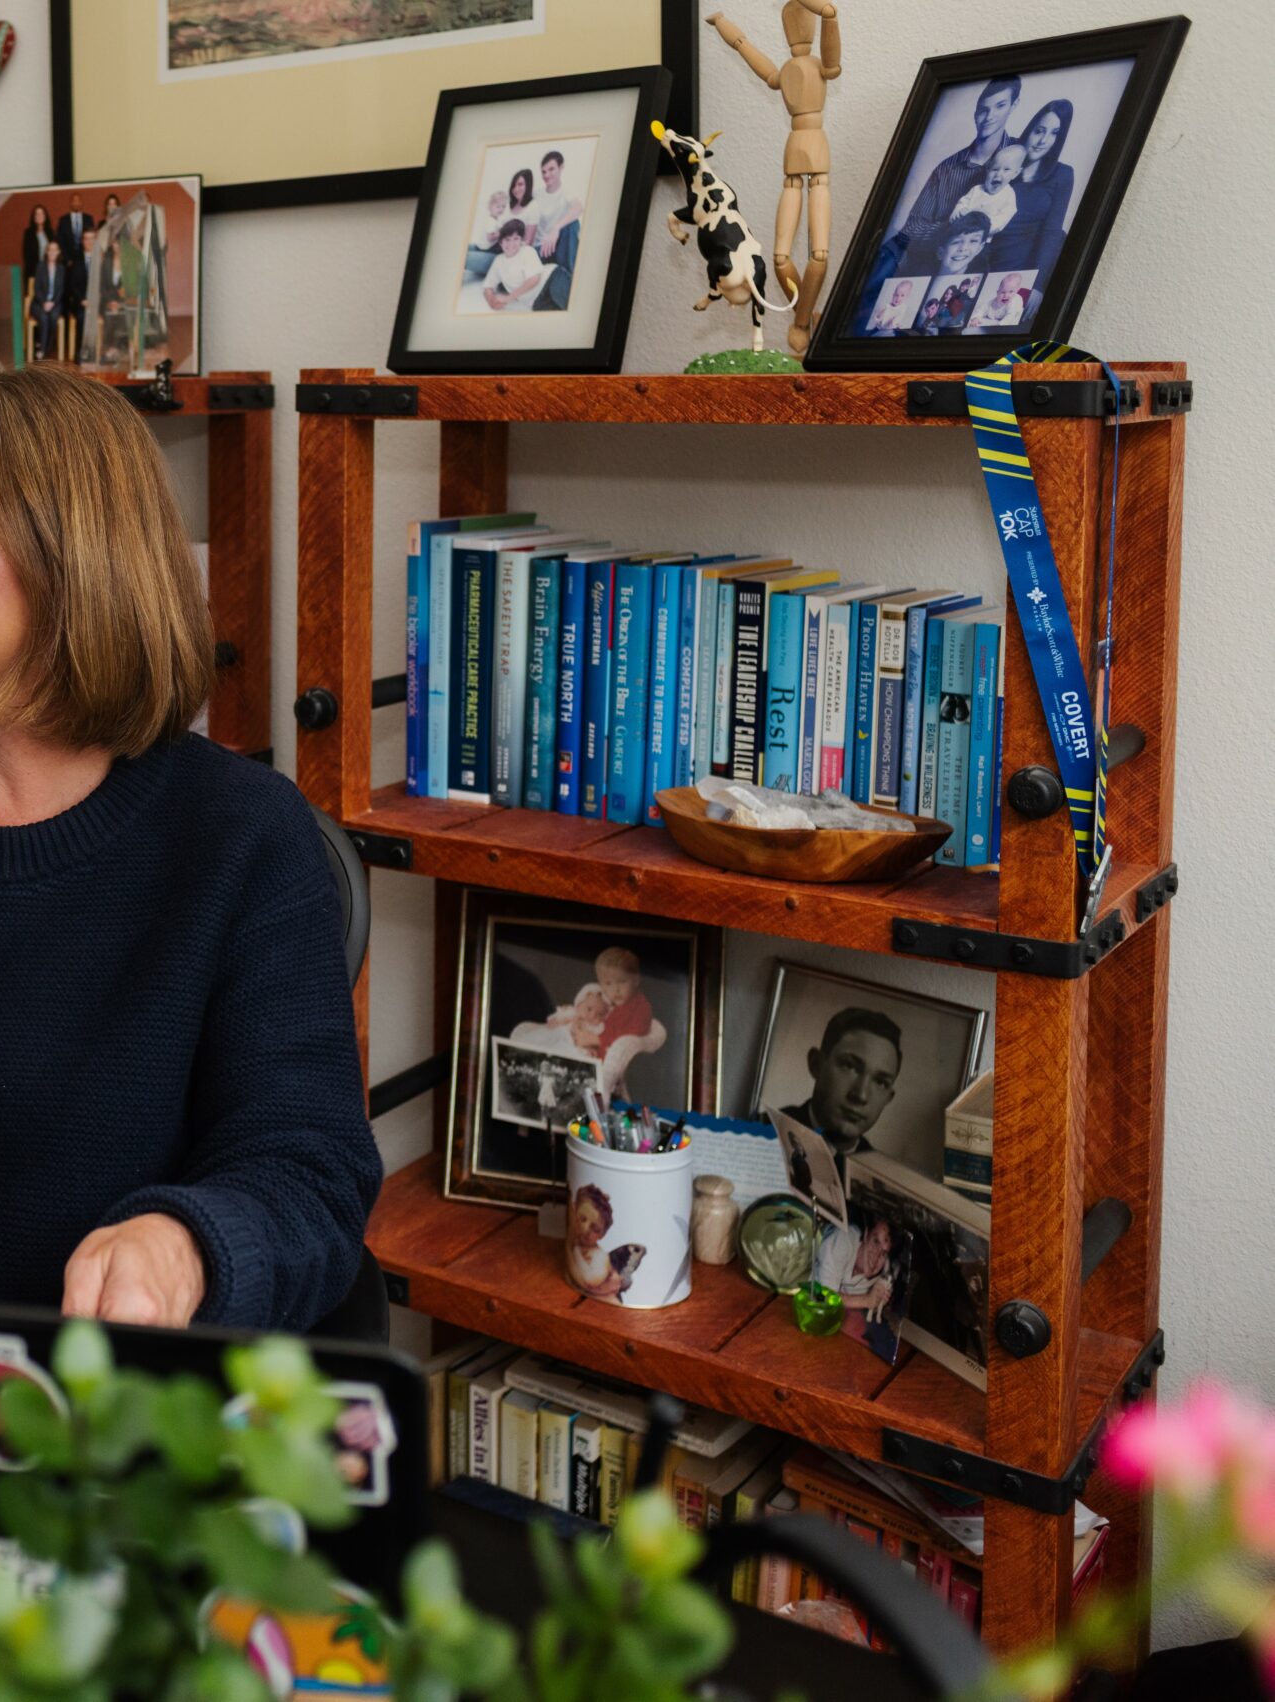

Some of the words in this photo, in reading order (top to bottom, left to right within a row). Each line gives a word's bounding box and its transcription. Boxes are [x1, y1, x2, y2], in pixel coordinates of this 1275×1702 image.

[999, 510, 1019, 541] 10K
[1014, 507, 1034, 538] CAP
[502, 561, 513, 584] THE
[1027, 551, 1037, 578] PRESENTED
[407, 596, 418, 614] the
[501, 590, 512, 637] SAFETY
[534, 576, 551, 620] Brain
[590, 581, 605, 614] Office
[467, 570, 481, 660] PHARMACEUTICAL
[618, 608, 633, 646] ORIGIN
[910, 610, 919, 635] LOOK
[1032, 605, 1043, 632] HEALTH
[406, 617, 419, 656] bipolar
[562, 623, 576, 665] TRUE
[590, 615, 602, 666] SUPERMAN
[655, 608, 668, 682] COMMUNICATE
[738, 625, 759, 647] THE
[809, 627, 818, 648] LOVE
[861, 617, 875, 659] PROOF
[883, 625, 892, 662] ROTELLA
[892, 644, 900, 661] BOB
[909, 637, 918, 648] AT
[500, 642, 511, 676] TRAP
[529, 625, 550, 684] Energy
[617, 647, 627, 662] OF
[808, 650, 817, 674] LIVES
[948, 629, 956, 688] NIFFENEGGER
[406, 659, 418, 717] workbook
[466, 661, 479, 689] CARE
[617, 664, 627, 685] THE
[654, 684, 665, 697] TO
[680, 646, 692, 708] COMPLEX
[735, 650, 758, 724] LEADERSHIP
[806, 675, 816, 699] HERE
[927, 670, 938, 697] BROWN
[560, 669, 575, 723] NORTH
[834, 669, 842, 714] AMERICAN
[859, 671, 873, 723] HEAVEN
[884, 682, 894, 706] HOW
[465, 690, 478, 738] PRACTICE
[651, 699, 664, 754] INFLUENCE
[768, 685, 796, 753] Rest
[825, 690, 833, 734] PARADOX
[906, 702, 916, 729] ABOVE
[974, 697, 985, 741] parenting
[1061, 691, 1090, 759] COVERT
[678, 713, 691, 746] PTSD
[882, 707, 893, 763] CHAMPIONS
[925, 723, 935, 753] BRAVING
[803, 737, 813, 769] MARIA
[942, 729, 952, 805] TRAVELER'S
[954, 755, 962, 781] THE
[978, 755, 986, 768] Hal
[881, 764, 891, 793] THINK
[922, 764, 933, 810] WILDERNESS
[976, 769, 985, 799] Runkel,
[953, 785, 961, 817] TIME
[474, 1392, 489, 1441] Allies
[474, 1446, 489, 1463] in
[575, 1460, 590, 1513] Multiple
